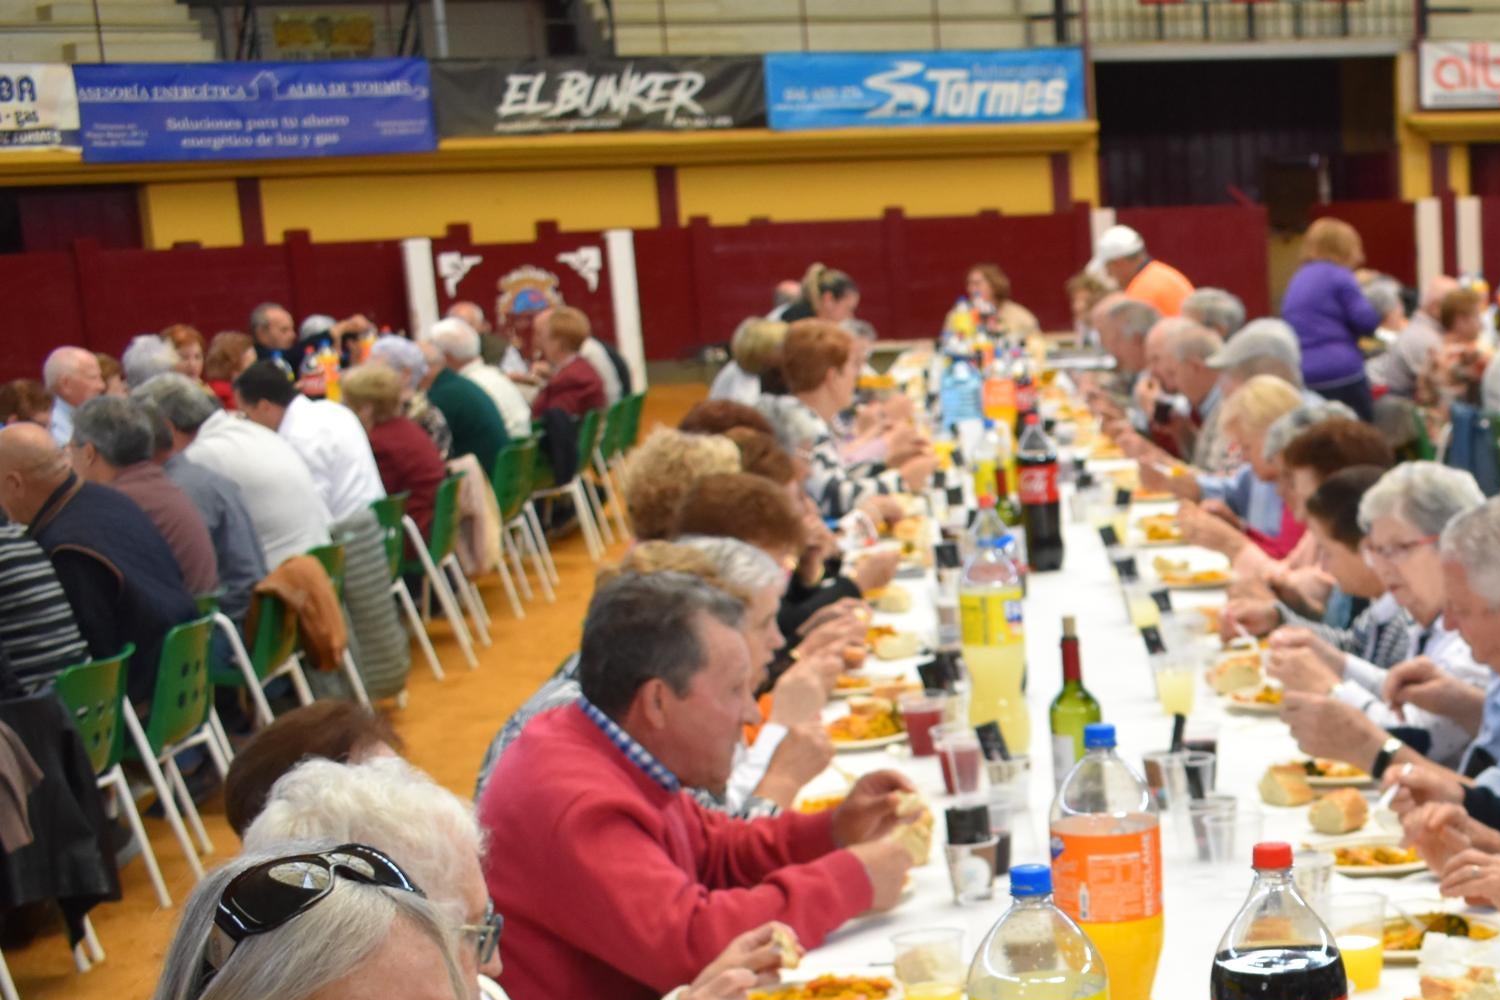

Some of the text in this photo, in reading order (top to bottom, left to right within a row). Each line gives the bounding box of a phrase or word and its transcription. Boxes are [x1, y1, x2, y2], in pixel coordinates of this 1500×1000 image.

[497, 62, 706, 124] EL BUNKER
[925, 68, 1068, 117] Tormes
[166, 117, 242, 131] Soluciones
